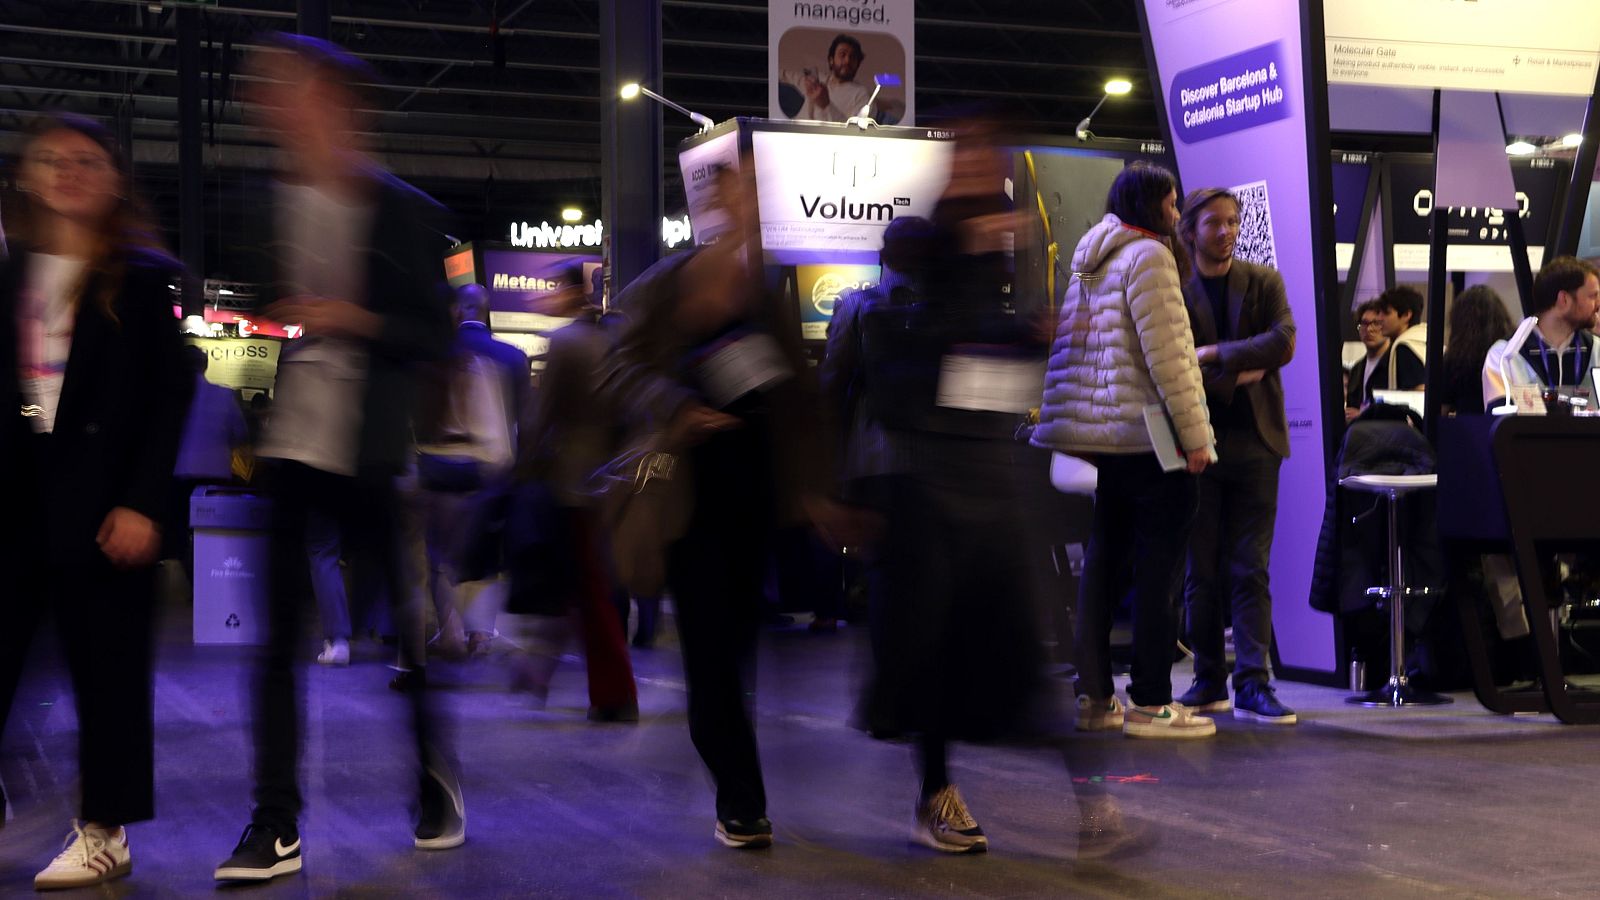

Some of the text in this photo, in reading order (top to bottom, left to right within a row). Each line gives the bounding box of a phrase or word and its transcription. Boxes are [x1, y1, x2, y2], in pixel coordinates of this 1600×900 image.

[1333, 44, 1397, 57] Molecular Gate
[1333, 58, 1356, 68] Making
[1357, 60, 1380, 70] product
[1181, 62, 1278, 106] Discover Barcelona &
[1183, 85, 1283, 128] Catalonia Startup Hub
[800, 194, 909, 221] Volum Tech
